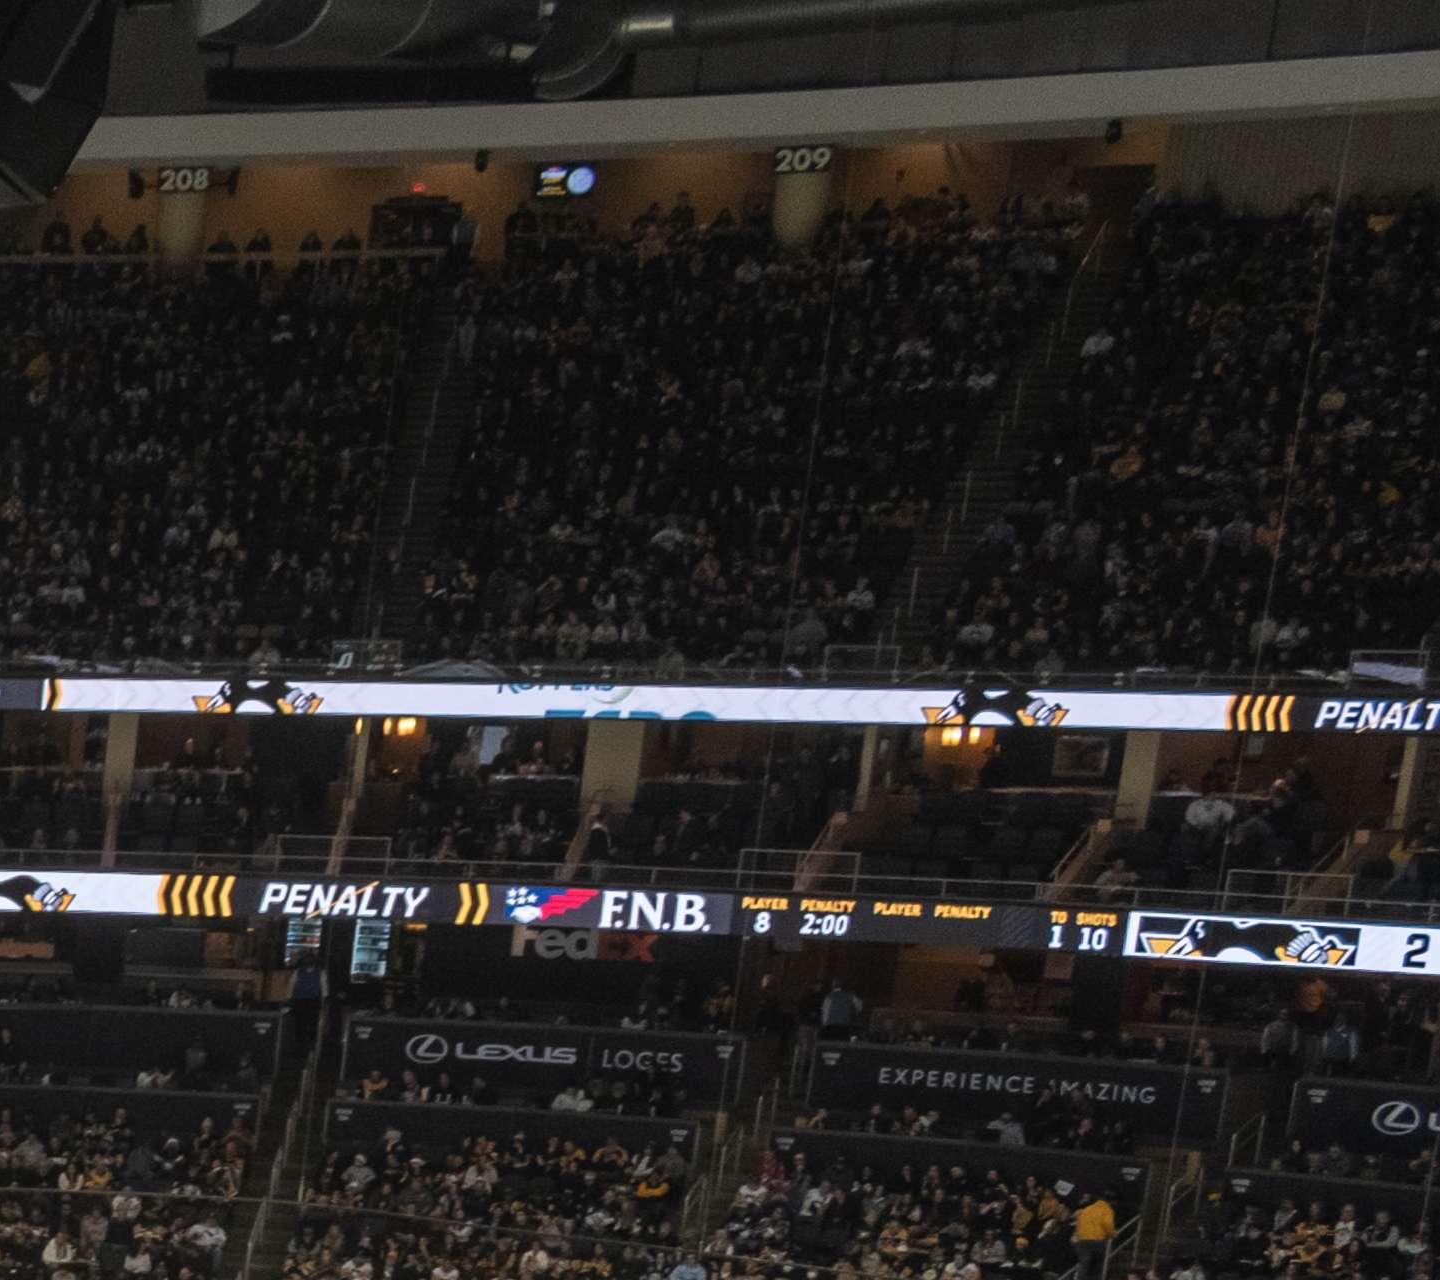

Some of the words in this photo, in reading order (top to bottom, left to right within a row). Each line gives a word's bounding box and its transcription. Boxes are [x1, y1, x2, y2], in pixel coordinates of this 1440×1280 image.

[774, 147, 831, 172] 209
[159, 167, 209, 192] 208
[258, 882, 430, 918] PENALTY
[597, 890, 711, 933] F.N.B.
[741, 896, 789, 911] PLAYER
[800, 898, 856, 913] PENALTY
[873, 902, 921, 917] PLAYER
[934, 904, 992, 919] PENALTY
[799, 914, 848, 935] 2:00
[1077, 927, 1109, 950] 10
[1402, 933, 1431, 968] 2
[455, 1042, 577, 1065] LEXUS
[602, 1048, 684, 1073] LOGES
[877, 1066, 1035, 1095] EXPERIENCE
